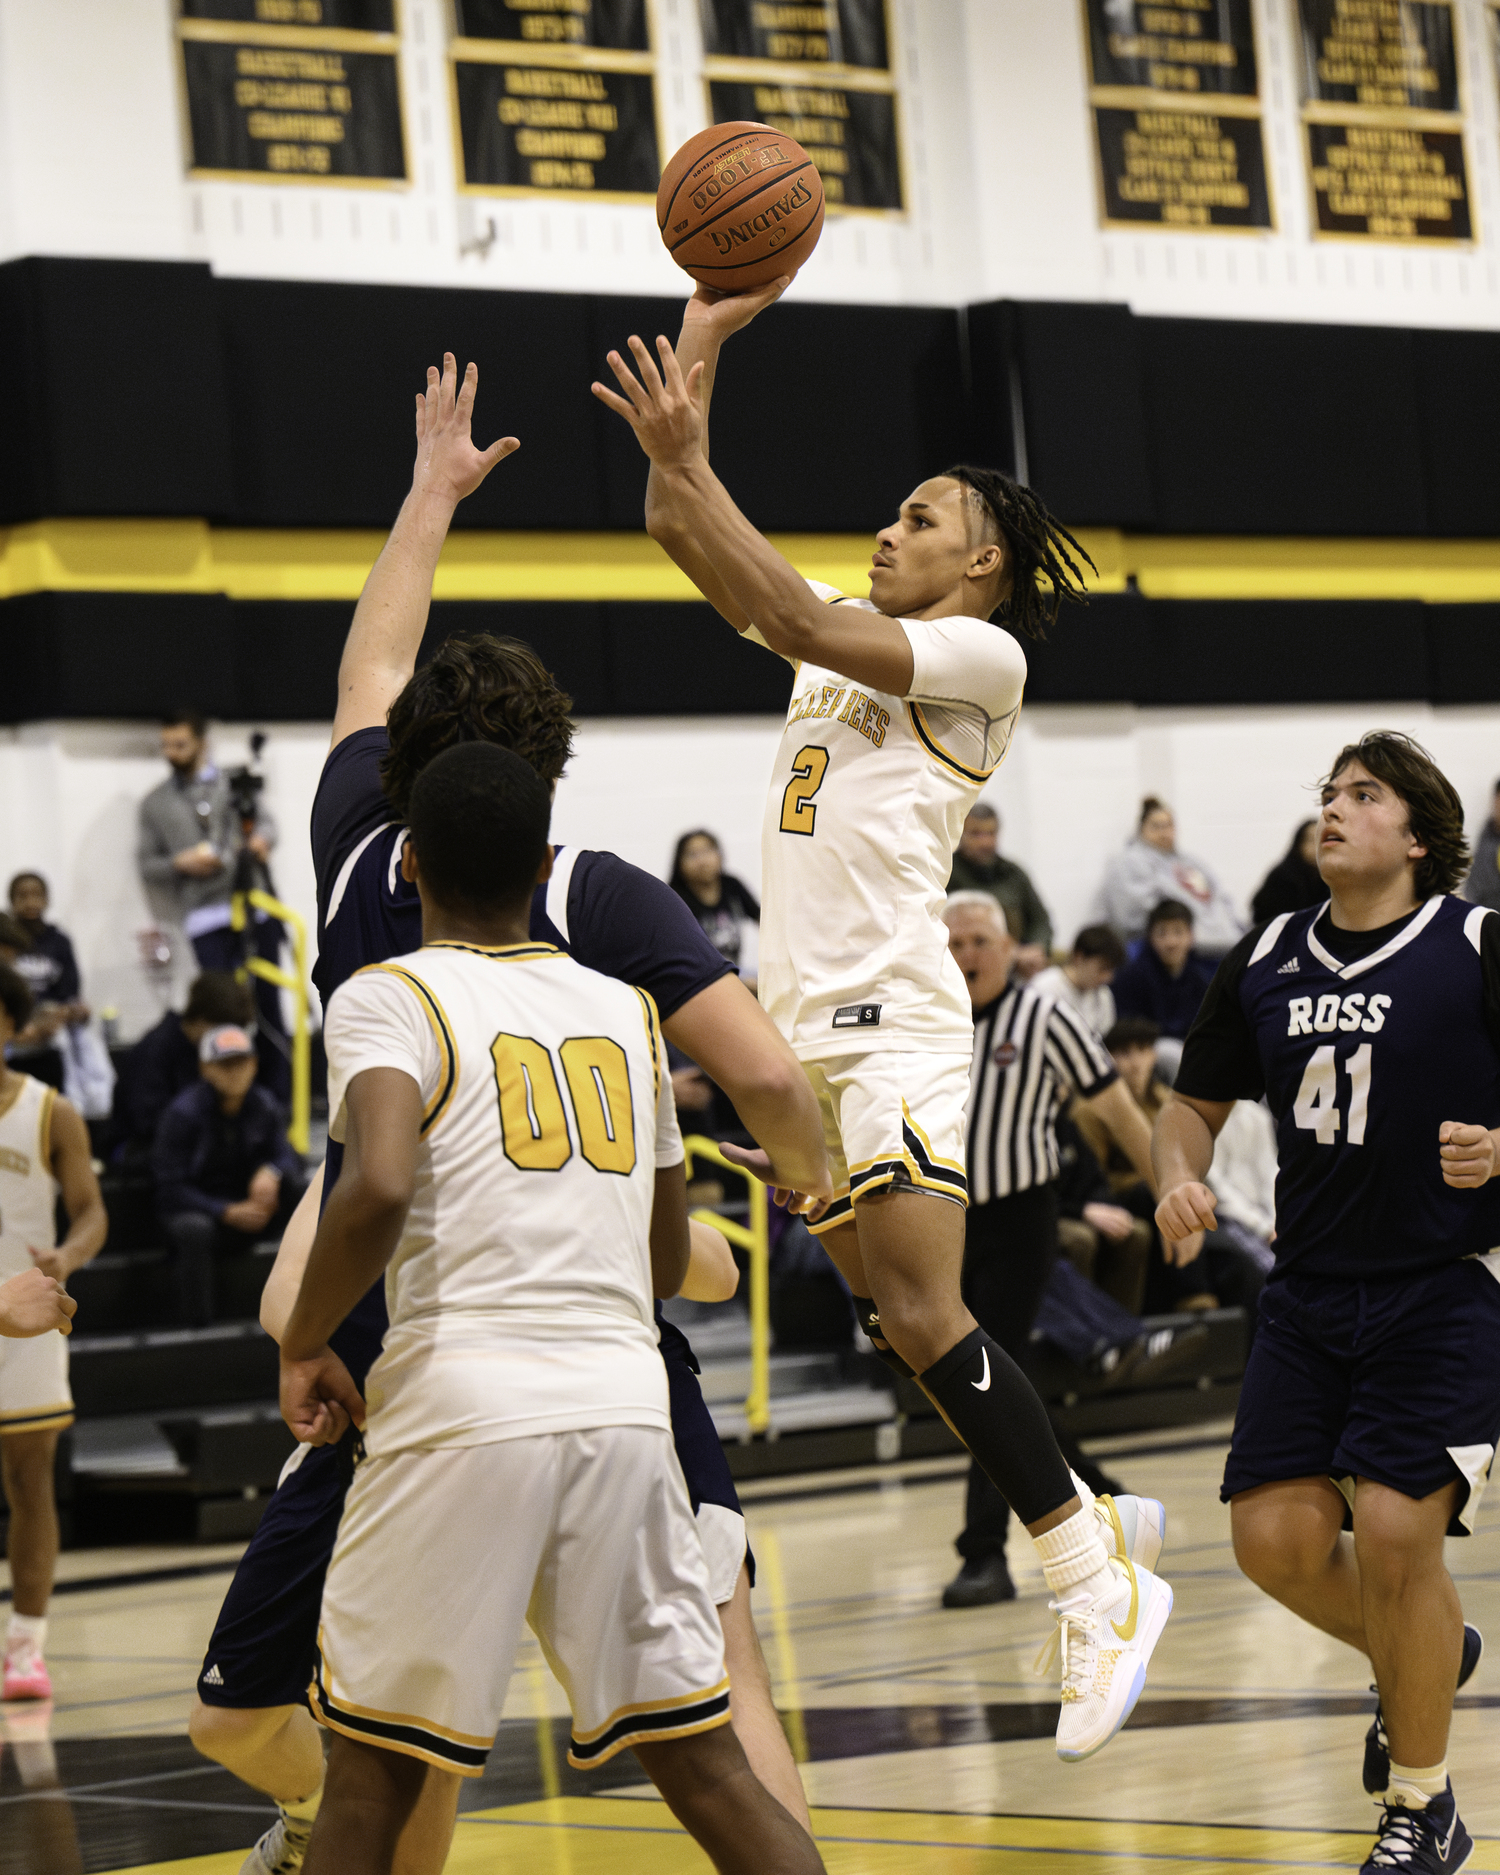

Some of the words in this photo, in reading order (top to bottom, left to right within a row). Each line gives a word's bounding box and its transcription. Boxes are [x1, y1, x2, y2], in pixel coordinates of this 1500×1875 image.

[691, 147, 789, 210] TF-1000
[713, 147, 751, 176] LEGACY
[711, 176, 812, 255] SPALDING
[779, 744, 830, 837] 2
[865, 1009, 873, 1020] S
[1287, 993, 1392, 1036] ROSS
[489, 1031, 637, 1177] 00
[1293, 1043, 1372, 1145] 41
